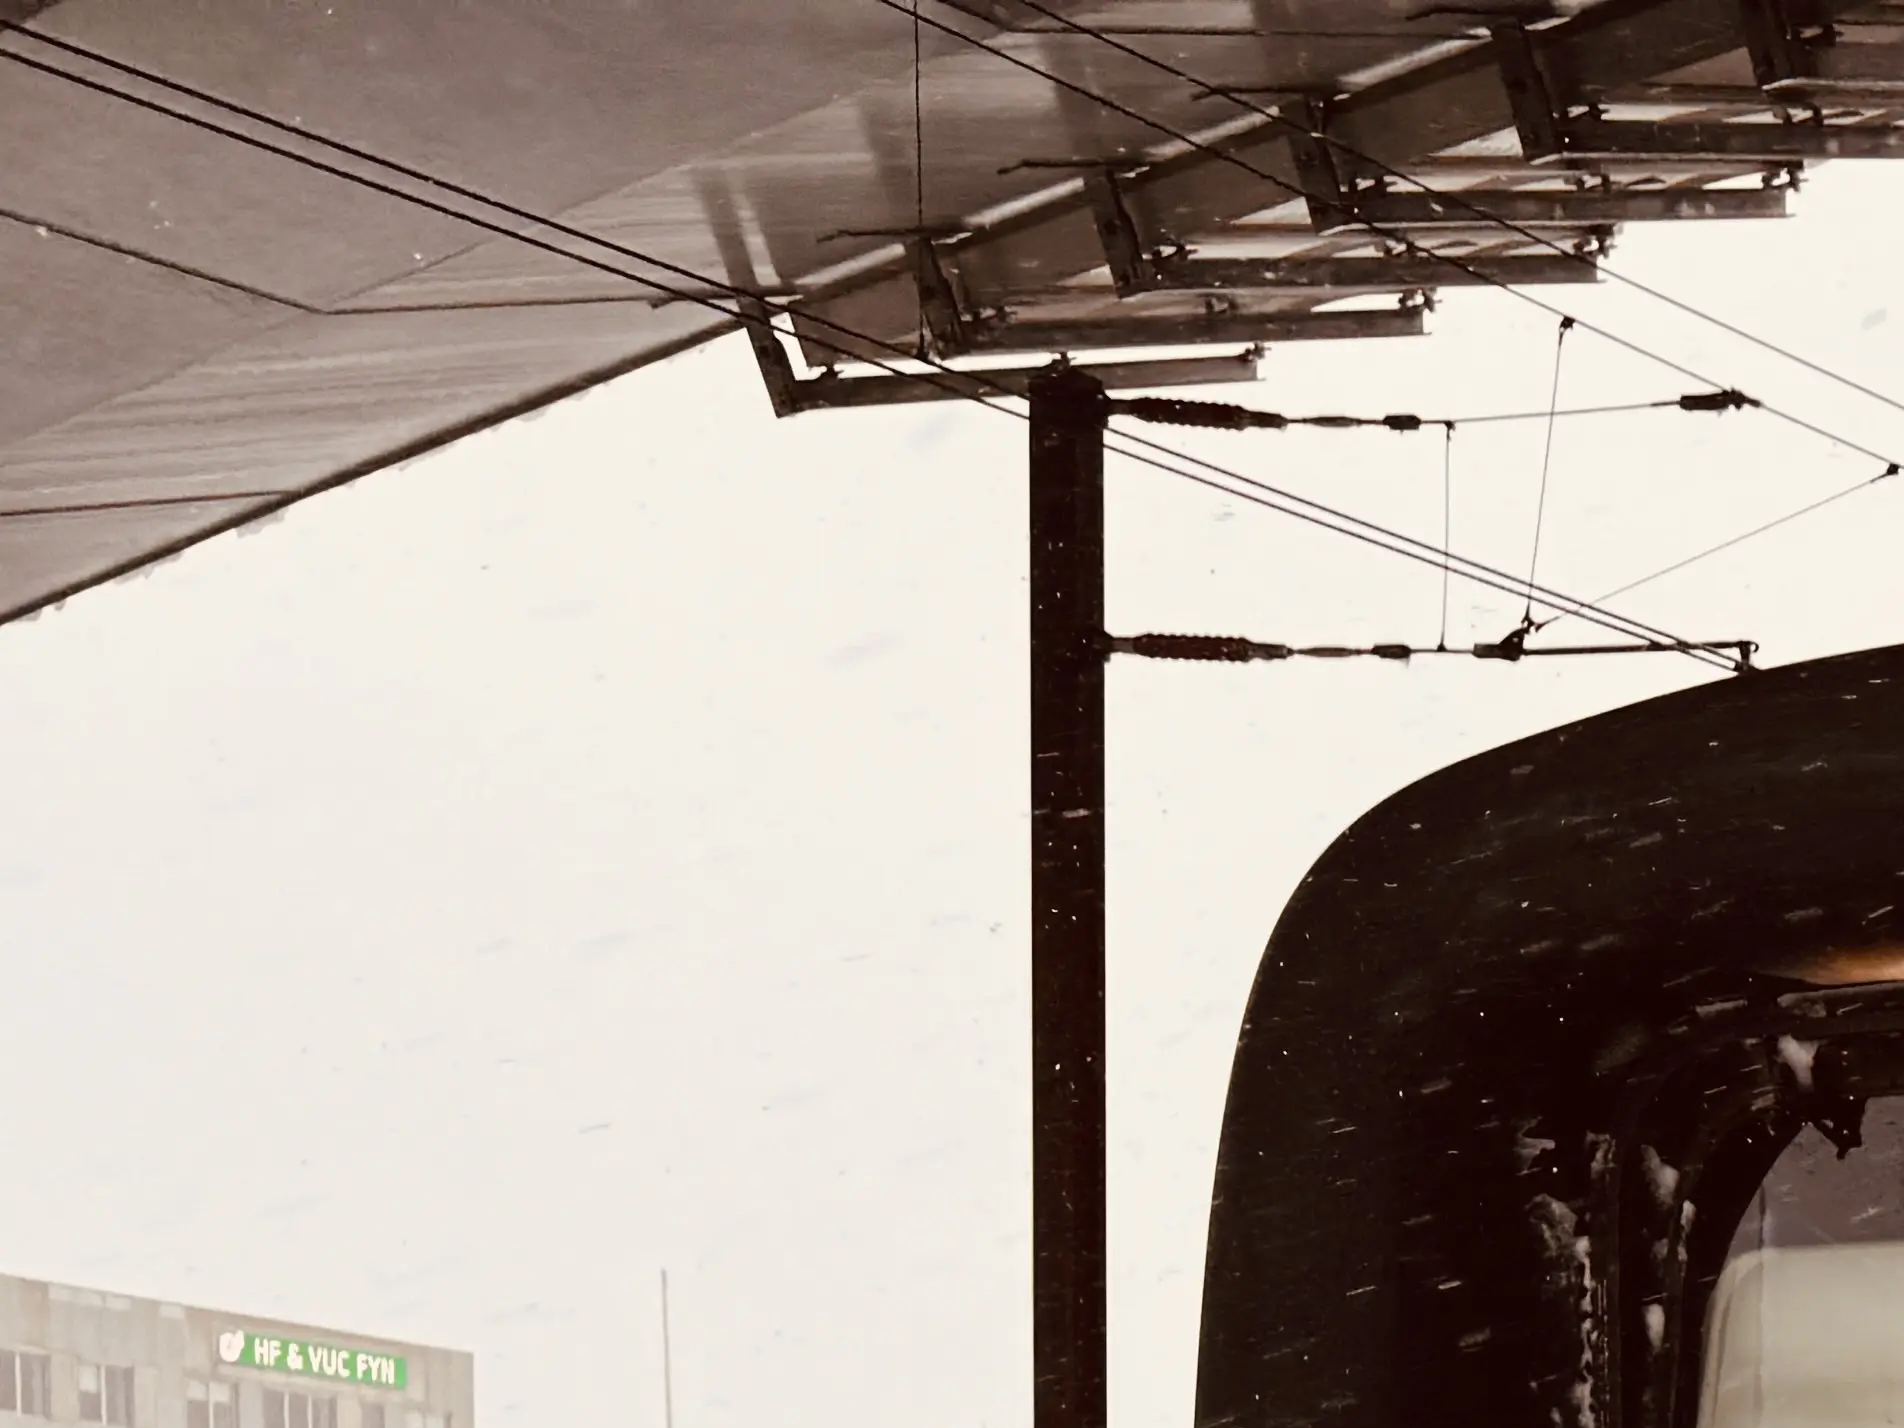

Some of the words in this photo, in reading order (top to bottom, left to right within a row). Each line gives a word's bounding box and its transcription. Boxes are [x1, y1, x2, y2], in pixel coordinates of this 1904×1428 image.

[254, 1338, 282, 1368] HF
[287, 1343, 304, 1371] &
[308, 1345, 350, 1378] VUC
[357, 1353, 396, 1385] FYN
